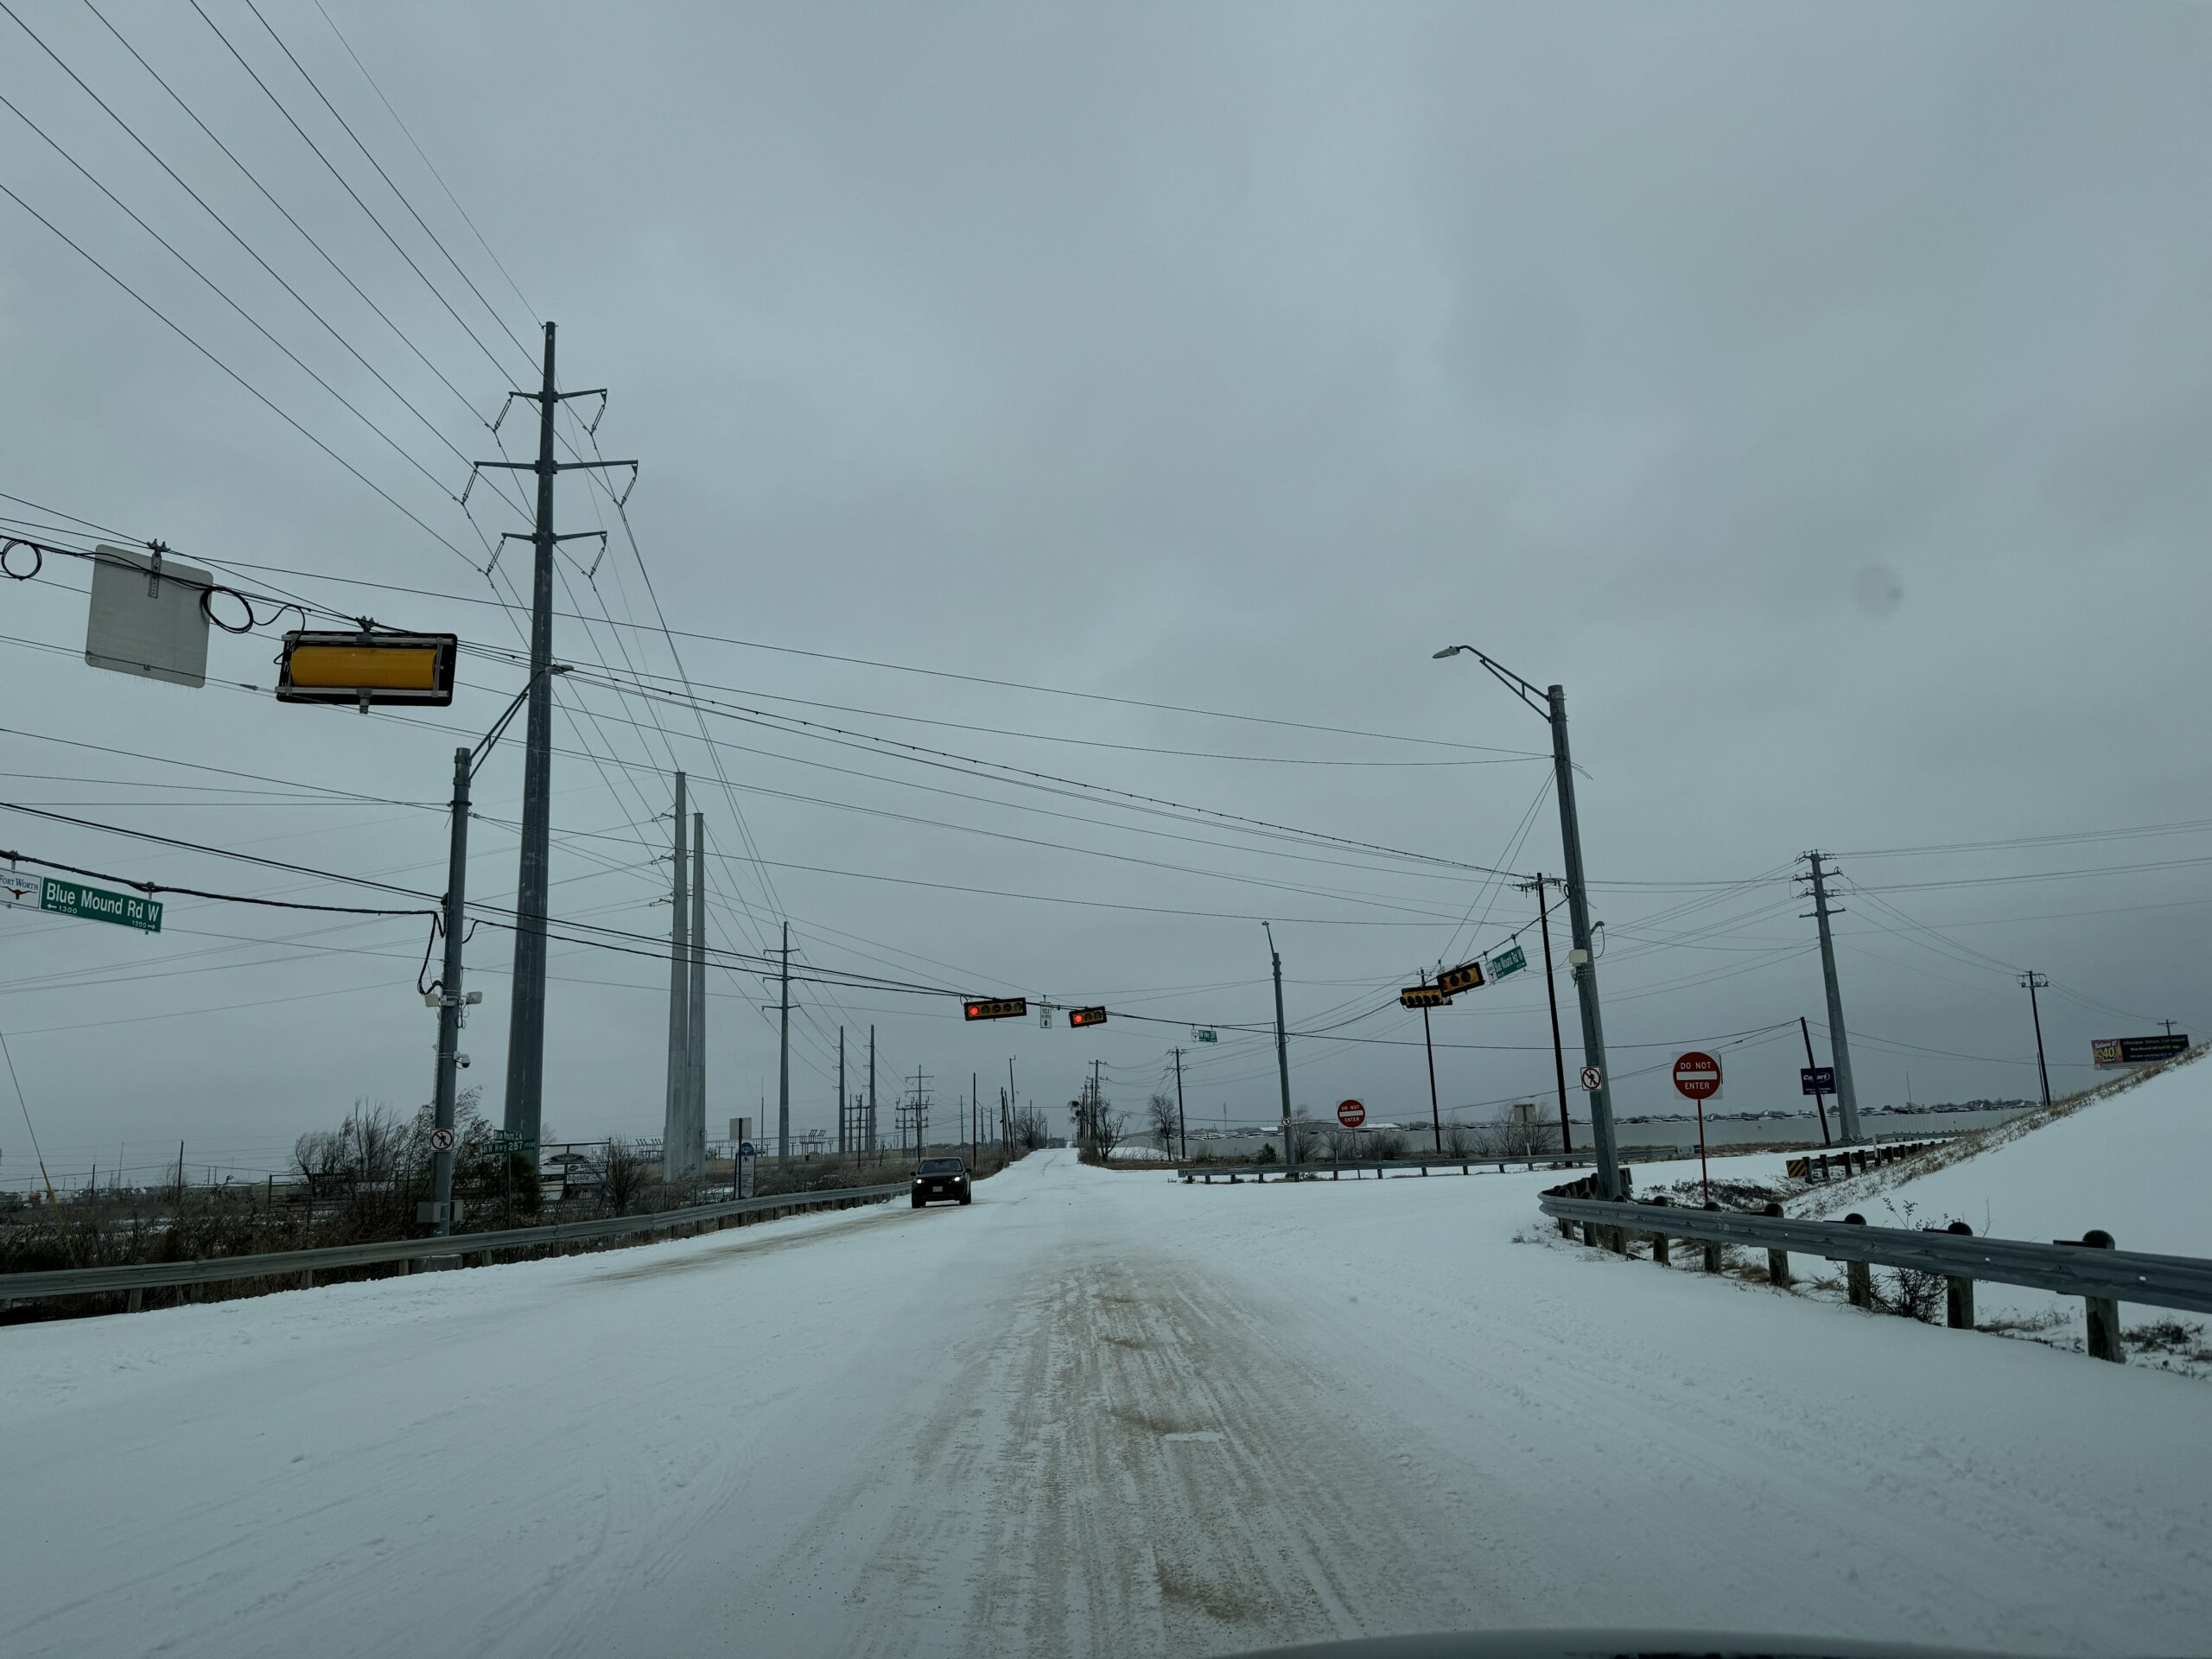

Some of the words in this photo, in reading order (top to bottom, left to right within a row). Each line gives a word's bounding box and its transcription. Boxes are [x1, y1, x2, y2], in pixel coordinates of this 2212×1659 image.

[16, 878, 39, 891] WORTH
[47, 882, 76, 905] Blue
[81, 889, 123, 914] Mound
[127, 899, 143, 918] Rd
[149, 904, 159, 922] W
[59, 905, 78, 914] 1300
[508, 1141, 524, 1151] 287
